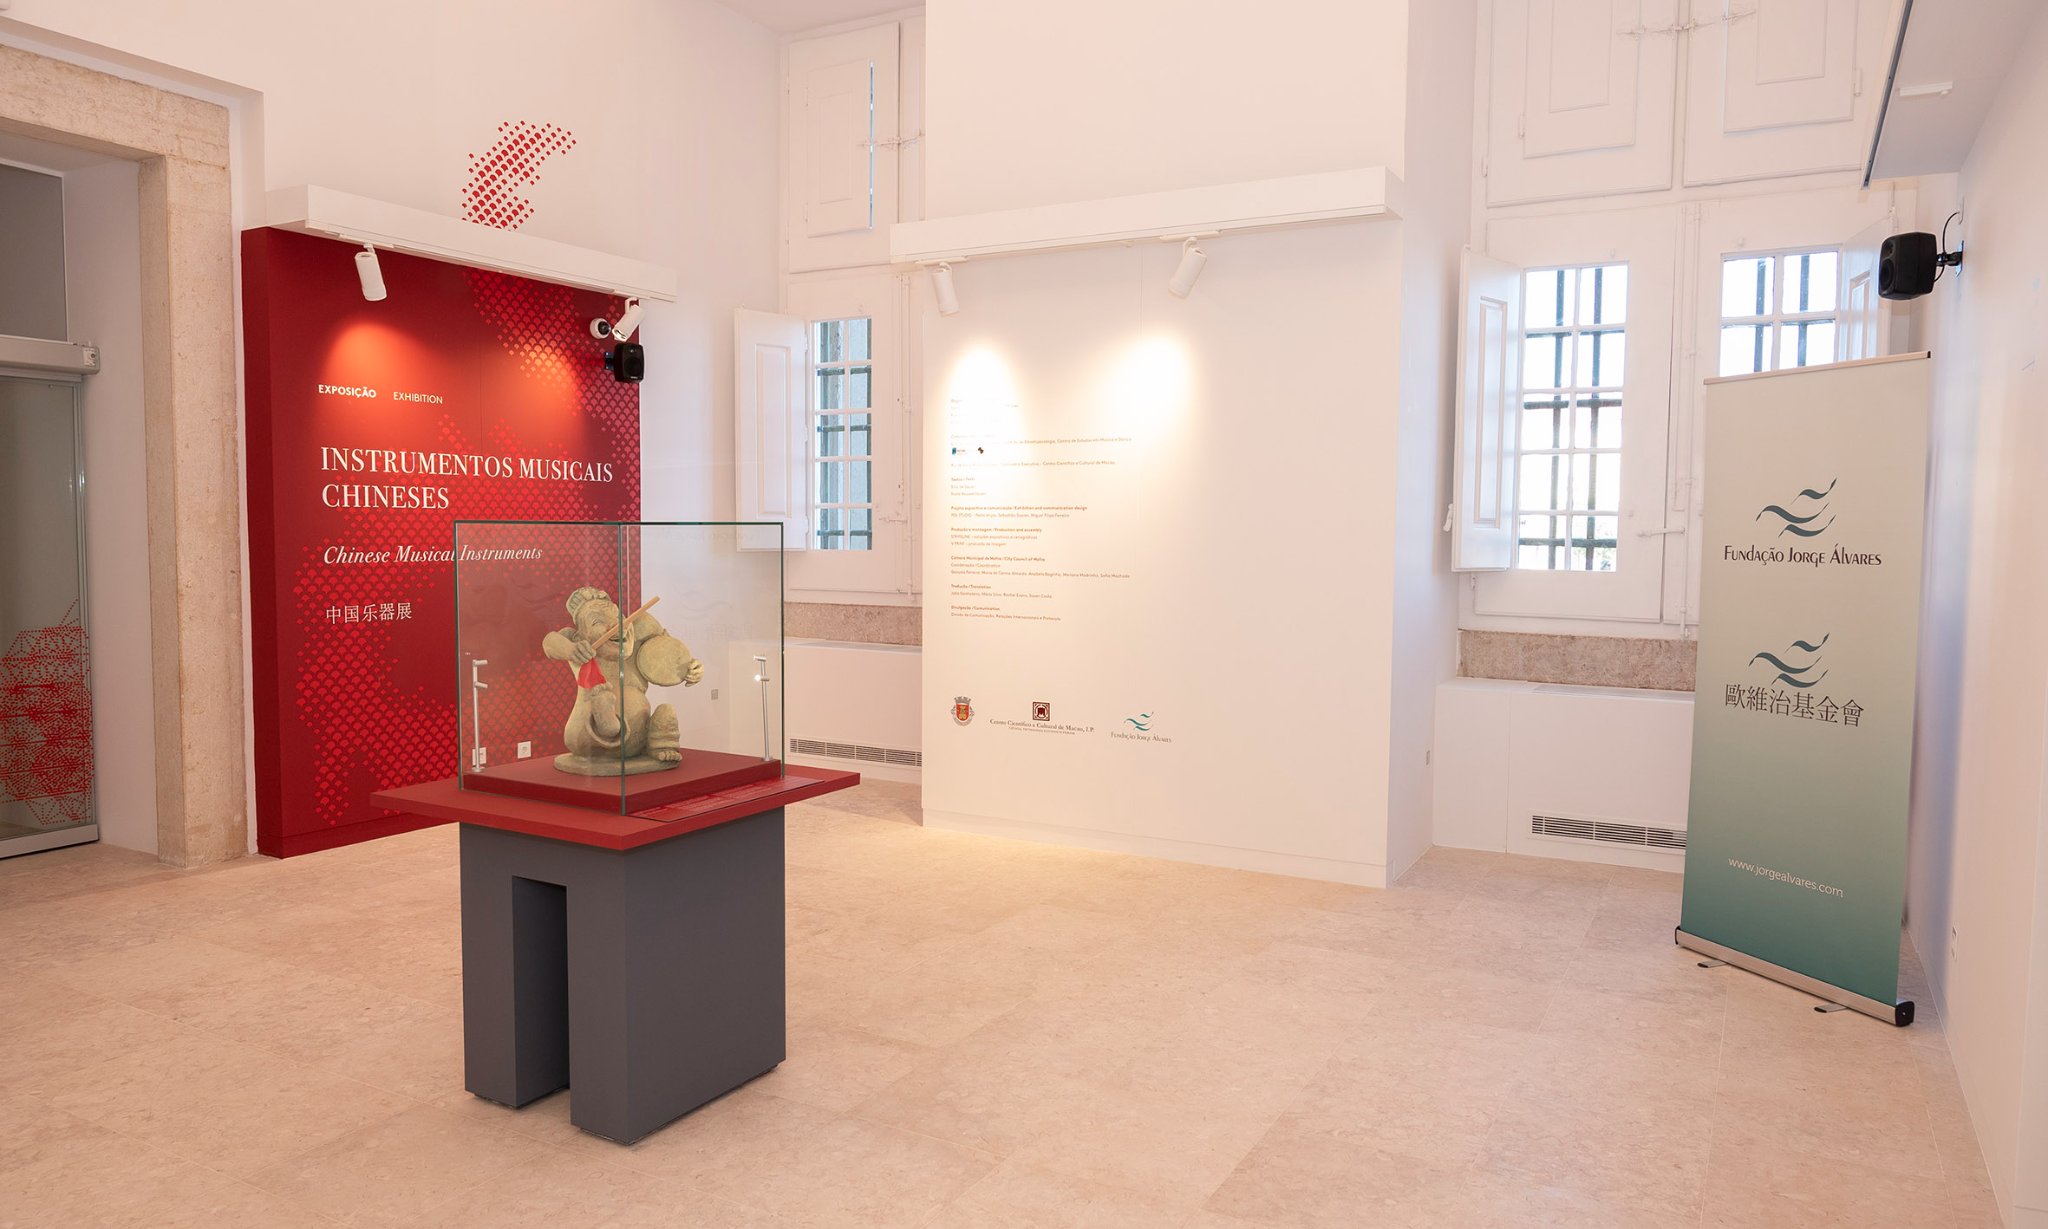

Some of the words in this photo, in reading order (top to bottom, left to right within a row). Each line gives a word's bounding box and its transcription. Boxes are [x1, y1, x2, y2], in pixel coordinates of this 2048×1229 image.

[318, 384, 377, 399] EXPOSIÇÃO
[393, 391, 443, 404] EXHIBITION
[321, 447, 513, 479] INSTRUMENTOS
[519, 458, 613, 482] MUSICAIS
[322, 484, 449, 509] CHINESES
[324, 545, 390, 564] Chinese
[394, 545, 456, 563] Musical
[460, 544, 543, 562] Instruments
[1724, 545, 1784, 566] Fundação
[1787, 547, 1826, 568] Jorge
[1829, 543, 1882, 566] Álvares
[325, 602, 412, 625] 中国乐器展
[1725, 684, 1865, 727] 歐維治基金會
[1728, 856, 1843, 897] www.jorgealvares.com
